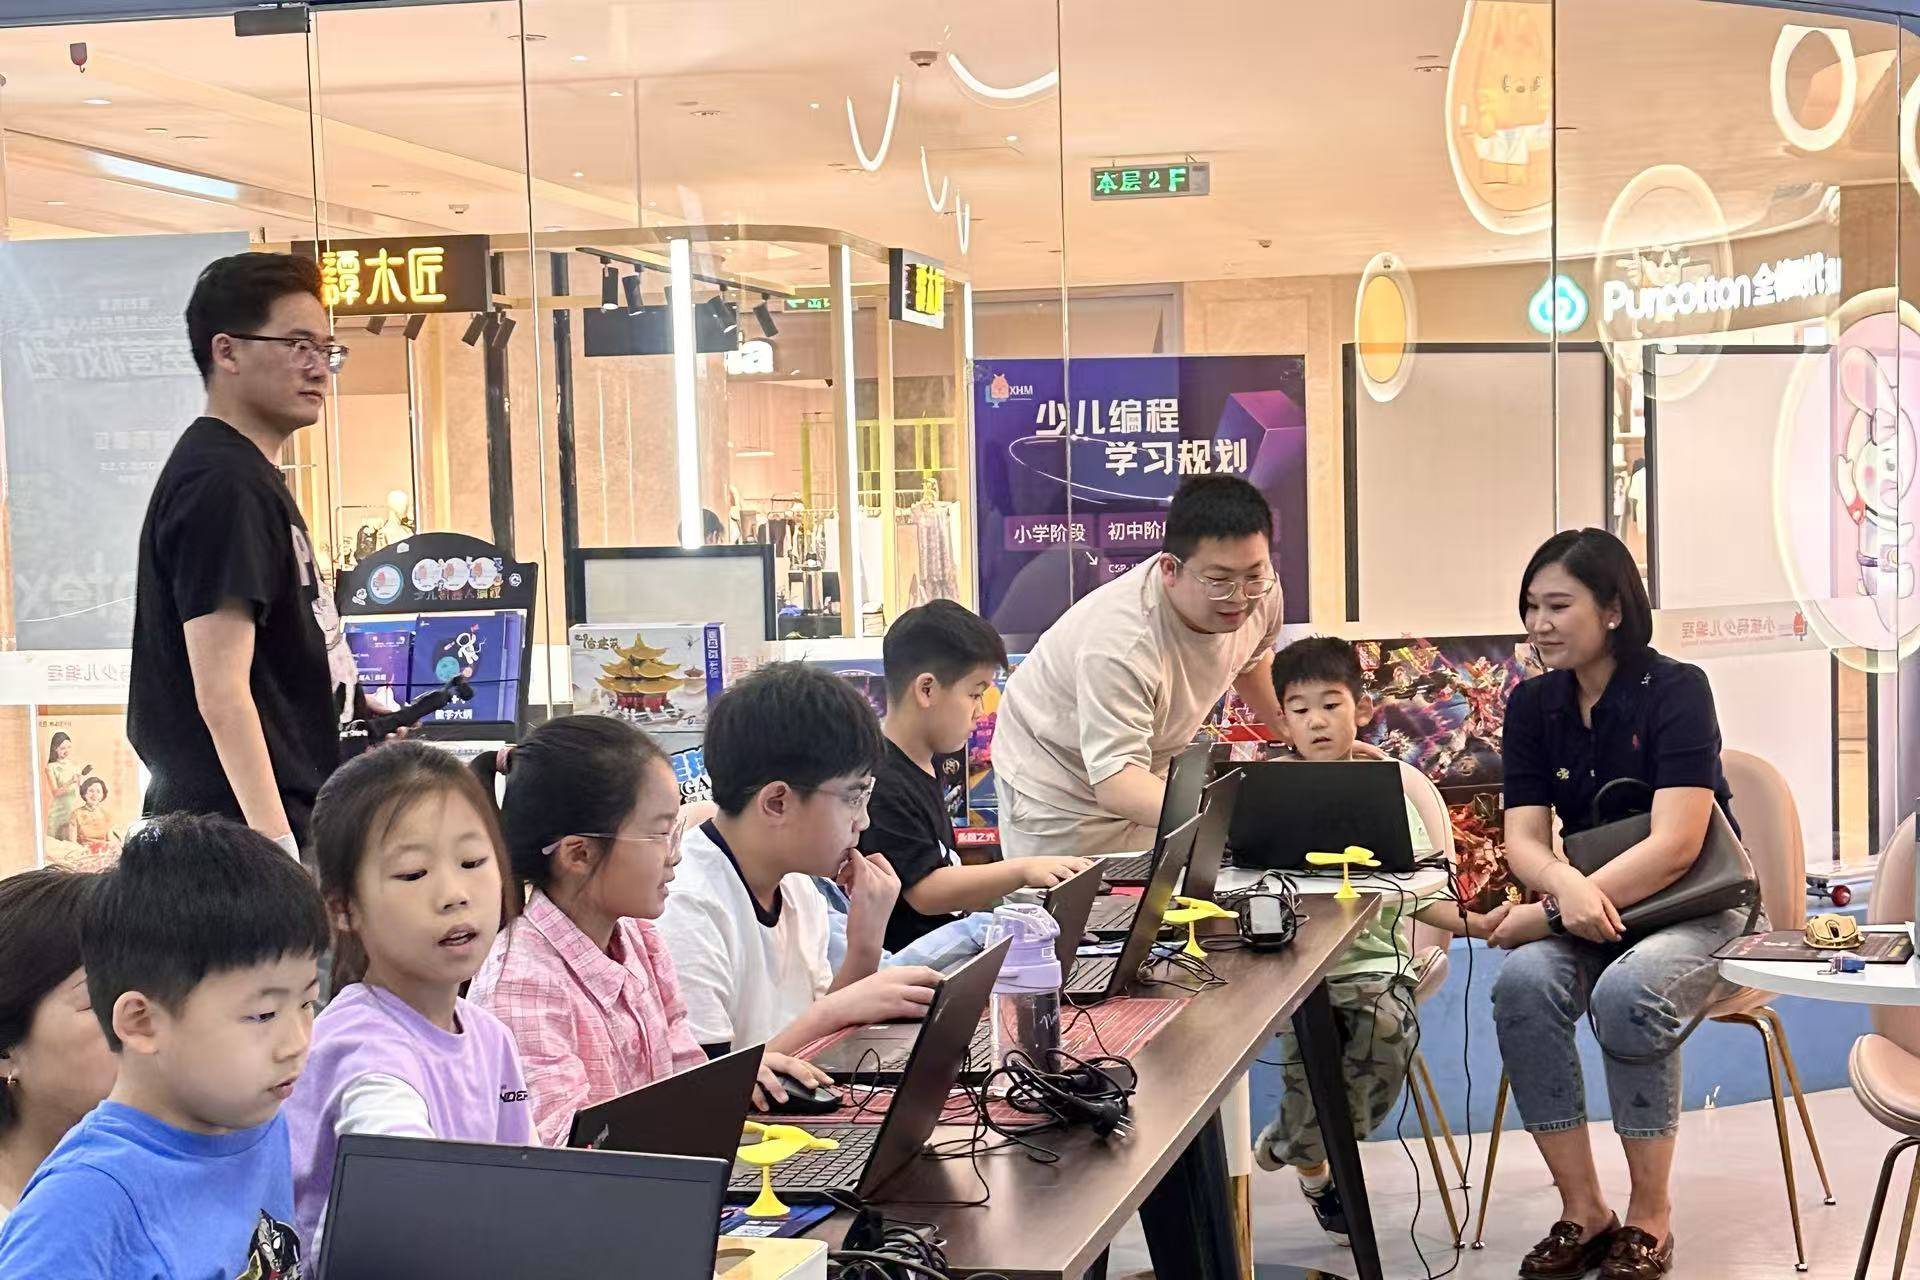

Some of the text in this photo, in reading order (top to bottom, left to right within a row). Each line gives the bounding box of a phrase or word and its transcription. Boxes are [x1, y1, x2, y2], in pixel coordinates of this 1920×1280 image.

[321, 246, 447, 305] 譚木匠
[1603, 274, 1751, 321] Purcotton
[1009, 384, 1033, 395] XHM
[1035, 399, 1180, 436] 少儿编程
[1105, 438, 1247, 476] 学习规划
[1014, 523, 1086, 544] 小学阶段
